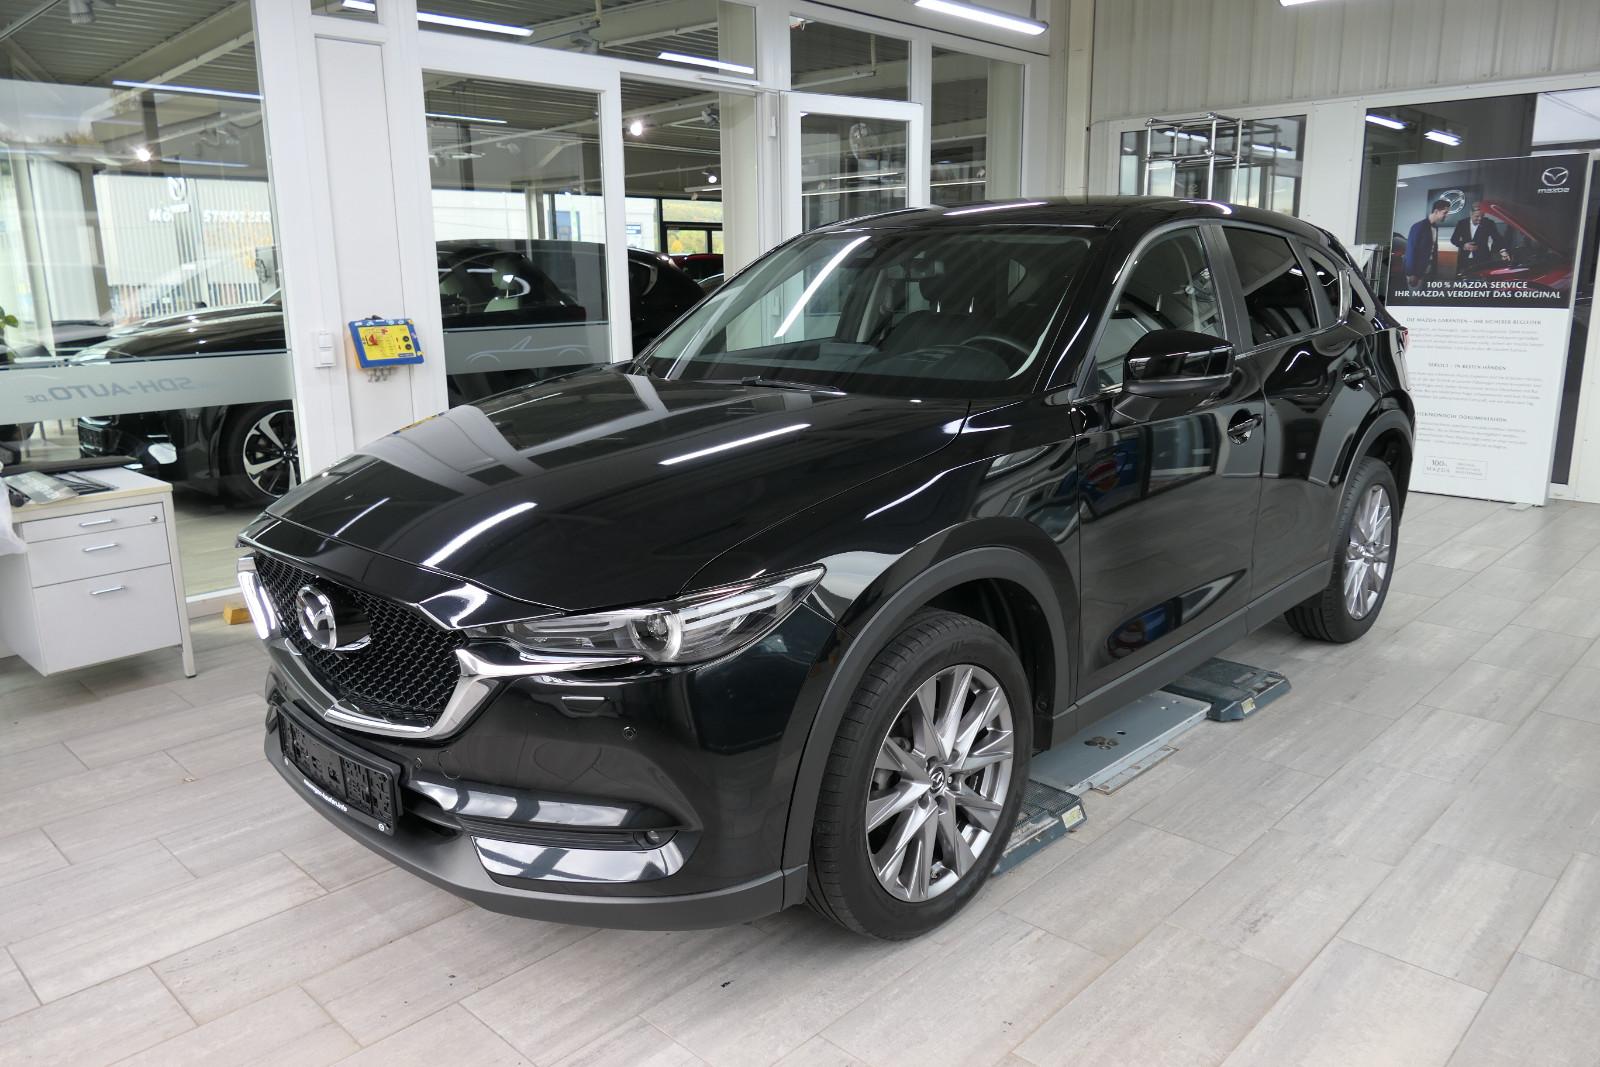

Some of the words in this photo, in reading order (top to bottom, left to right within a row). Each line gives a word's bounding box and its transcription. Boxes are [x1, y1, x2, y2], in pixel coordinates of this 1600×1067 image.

[1453, 281, 1488, 289] MAZDA
[1490, 281, 1528, 289] SERVICE
[1412, 290, 1445, 298] MAZDA
[1447, 290, 1491, 298] VERDIENT
[1514, 291, 1561, 299] ORIGINAL
